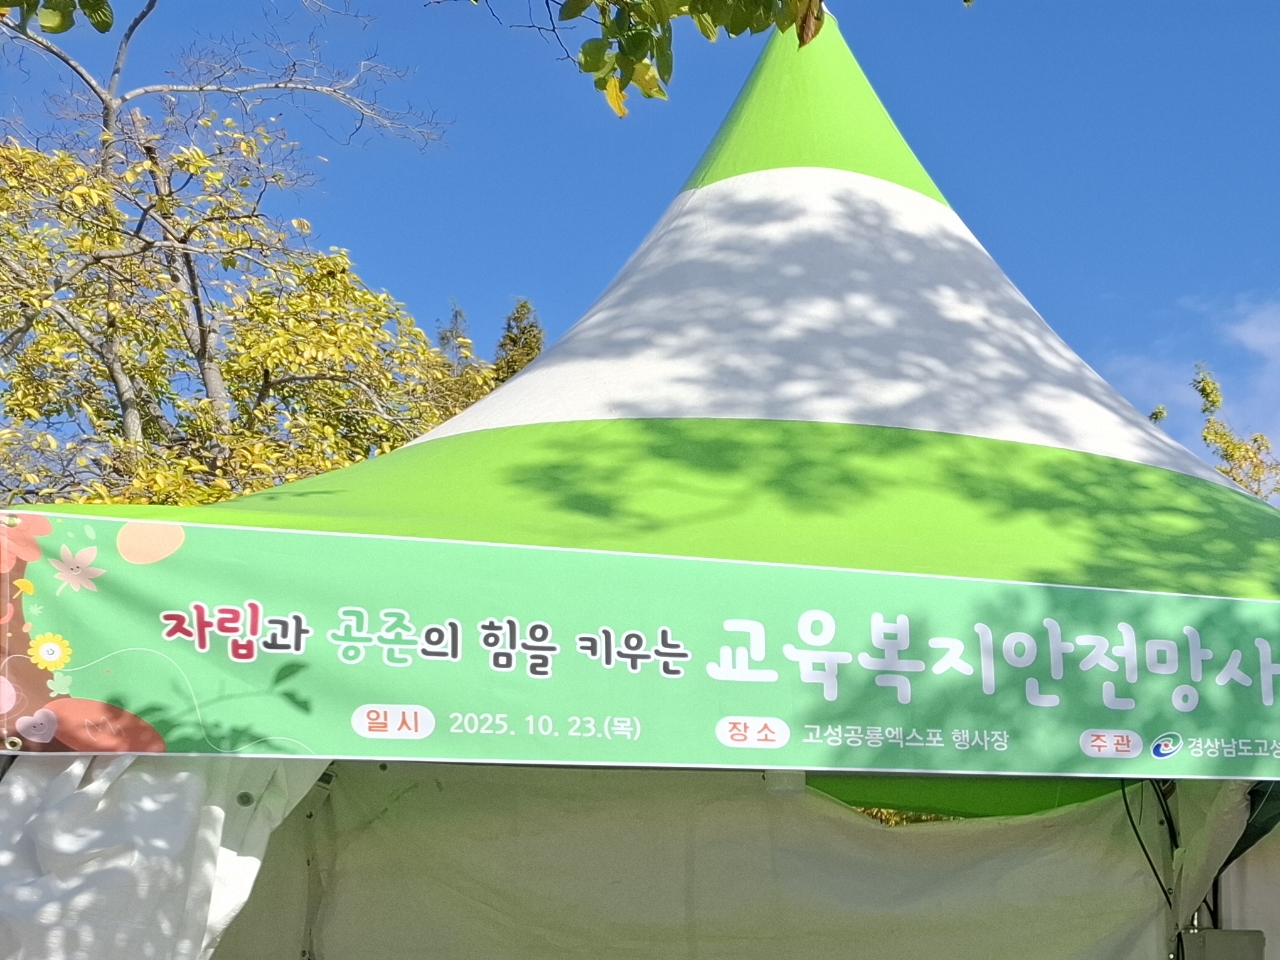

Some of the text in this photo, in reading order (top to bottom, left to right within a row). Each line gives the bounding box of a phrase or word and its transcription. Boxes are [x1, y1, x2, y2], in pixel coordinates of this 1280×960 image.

[161, 601, 311, 661] 자립과
[328, 608, 461, 665] 공존의
[479, 617, 559, 677] 힘을
[577, 627, 690, 677] 키우는
[449, 713, 515, 736] 2025.
[525, 714, 560, 738] 10.
[567, 715, 641, 741] 23.(목)
[802, 724, 944, 748] 고성공룡엑스포
[951, 729, 1009, 751] 행사장
